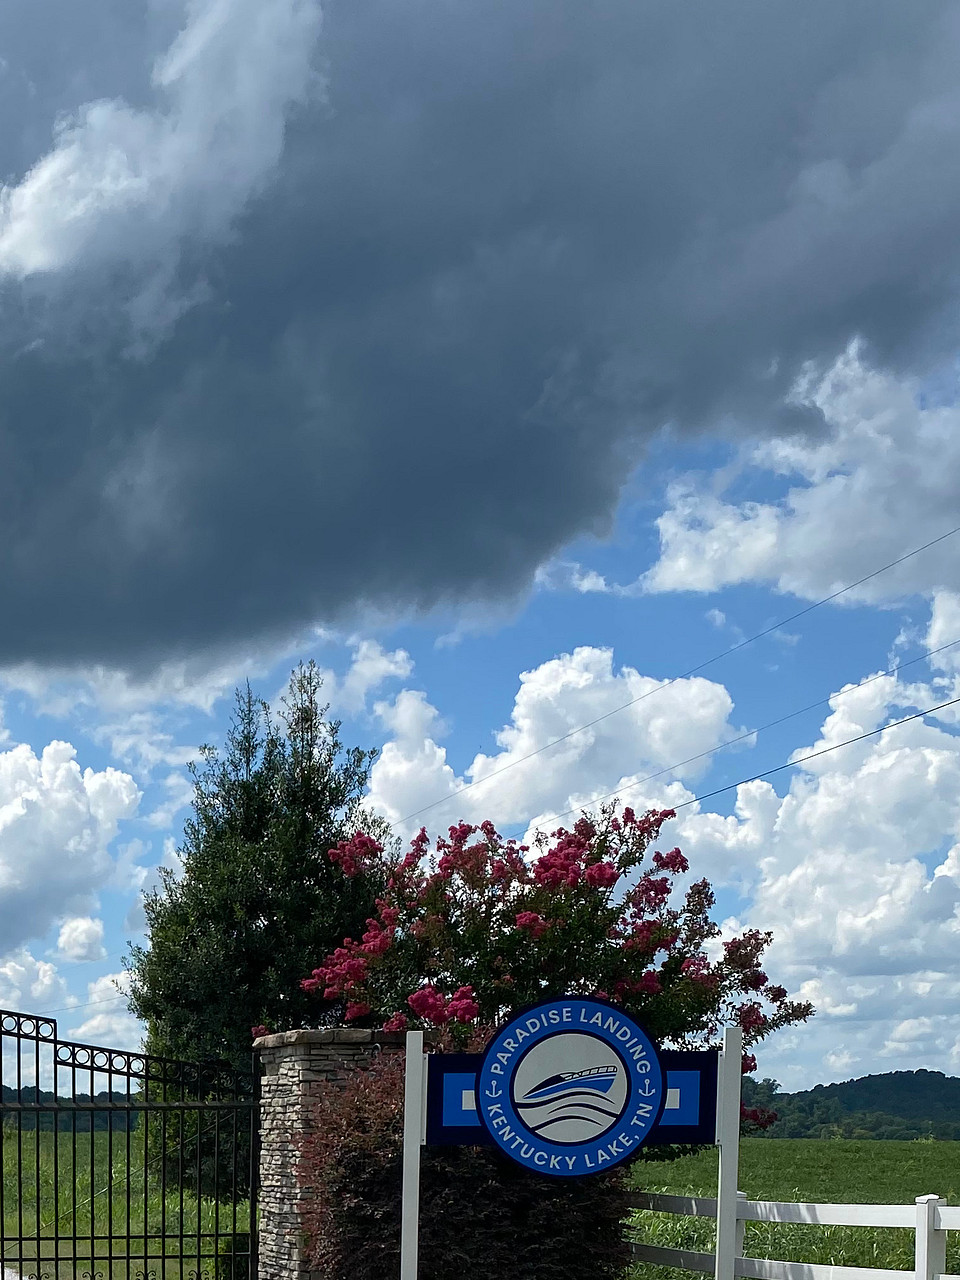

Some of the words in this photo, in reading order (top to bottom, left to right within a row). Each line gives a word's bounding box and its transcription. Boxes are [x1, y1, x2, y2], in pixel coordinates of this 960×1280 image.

[490, 1007, 572, 1075] PARADISE
[579, 1008, 651, 1074] LANDING
[487, 1104, 577, 1170] KENTUCKY
[584, 1132, 640, 1168] LAKE,
[630, 1103, 653, 1128] TN
